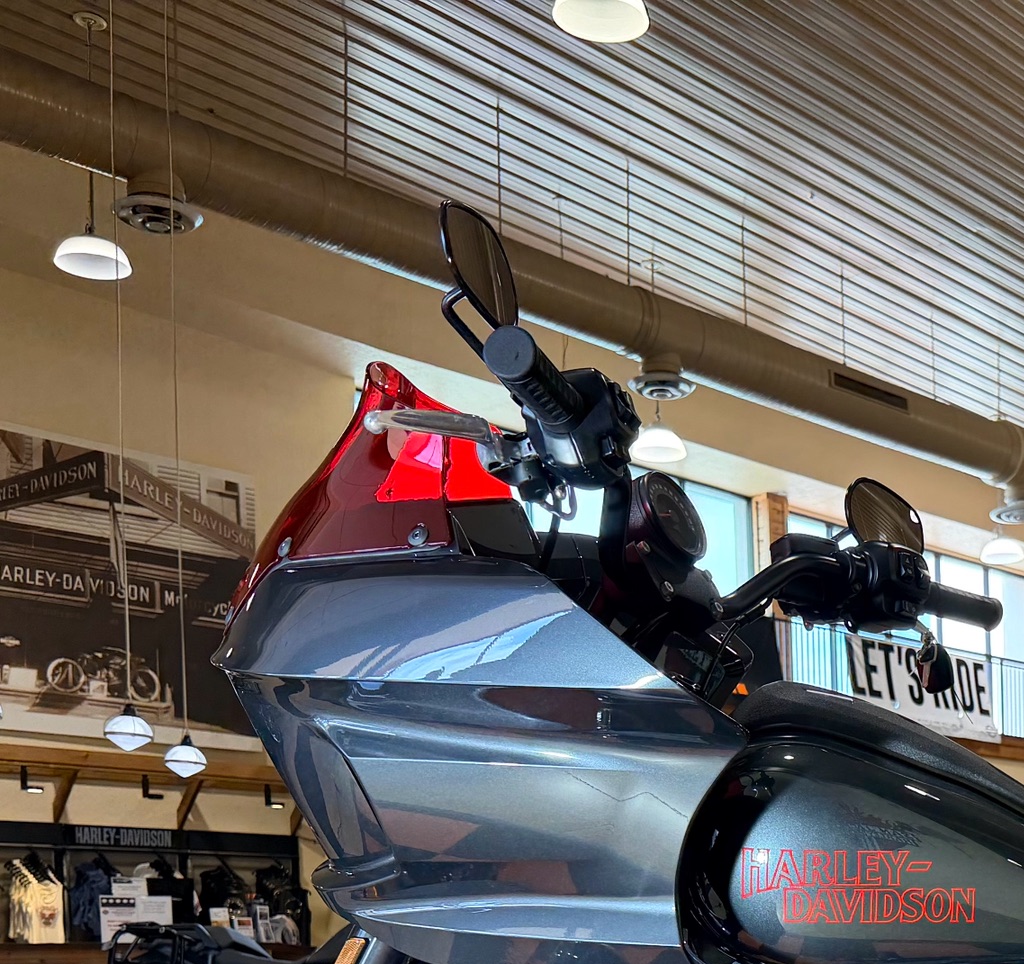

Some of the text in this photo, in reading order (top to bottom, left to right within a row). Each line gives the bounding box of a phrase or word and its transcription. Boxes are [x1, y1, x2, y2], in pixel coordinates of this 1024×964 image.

[0, 461, 97, 501] LEY-DAVIDSON
[849, 636, 925, 706] LET'S
[75, 826, 172, 847] HARLEY-DAVIDSON
[741, 847, 932, 899] HARLEY-
[782, 887, 976, 924] DAVIDSON
